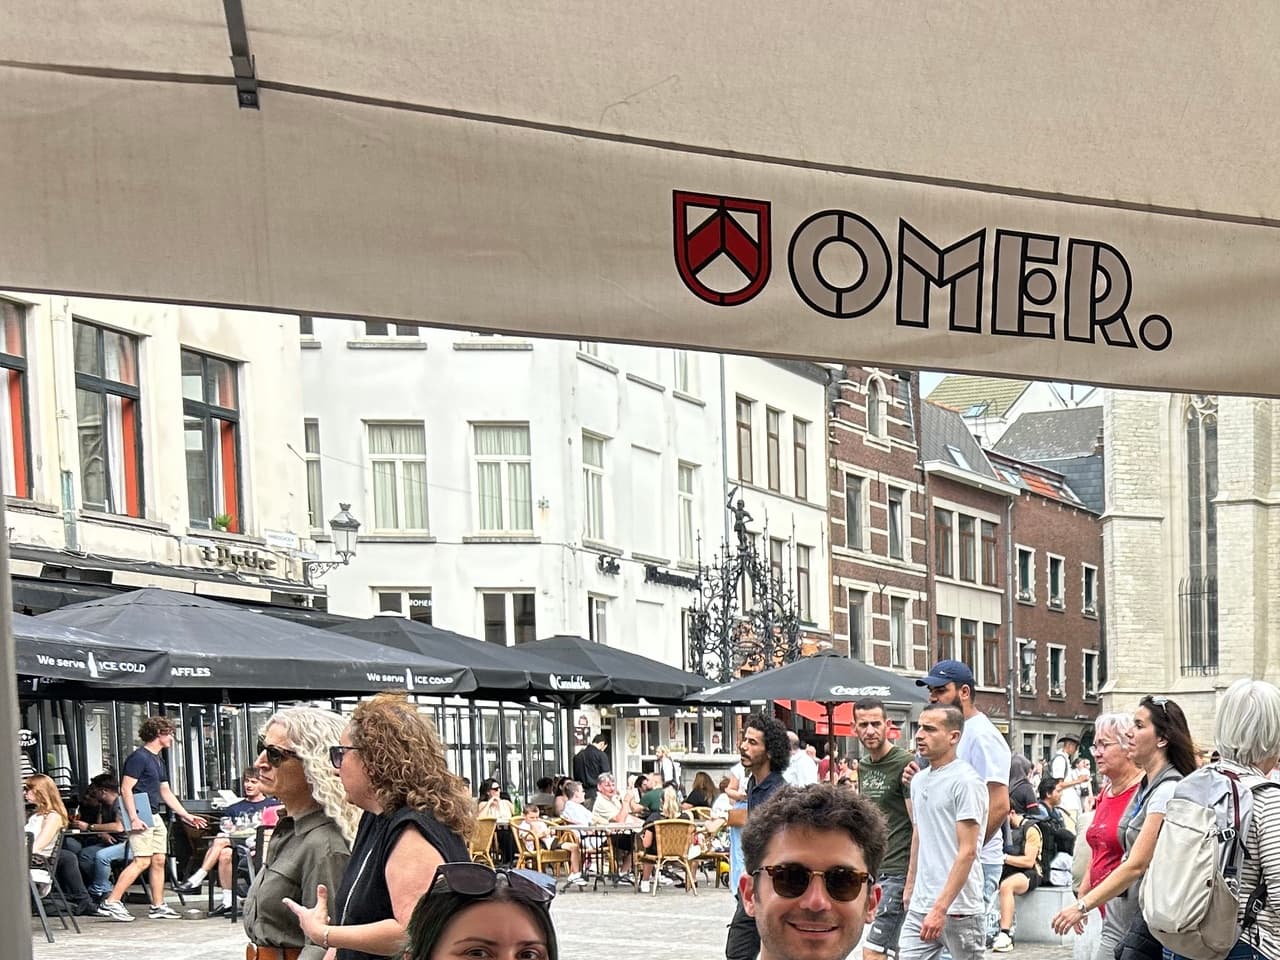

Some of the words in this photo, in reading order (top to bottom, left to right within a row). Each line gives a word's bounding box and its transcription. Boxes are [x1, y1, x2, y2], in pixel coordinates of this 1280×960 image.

[788, 209, 1173, 352] OMER.
[36, 654, 55, 665] We
[55, 659, 86, 669] serve
[98, 661, 118, 671] ICE
[119, 662, 146, 673] COLD
[366, 672, 381, 682] We
[381, 674, 405, 683] serve
[415, 675, 428, 684] ICE
